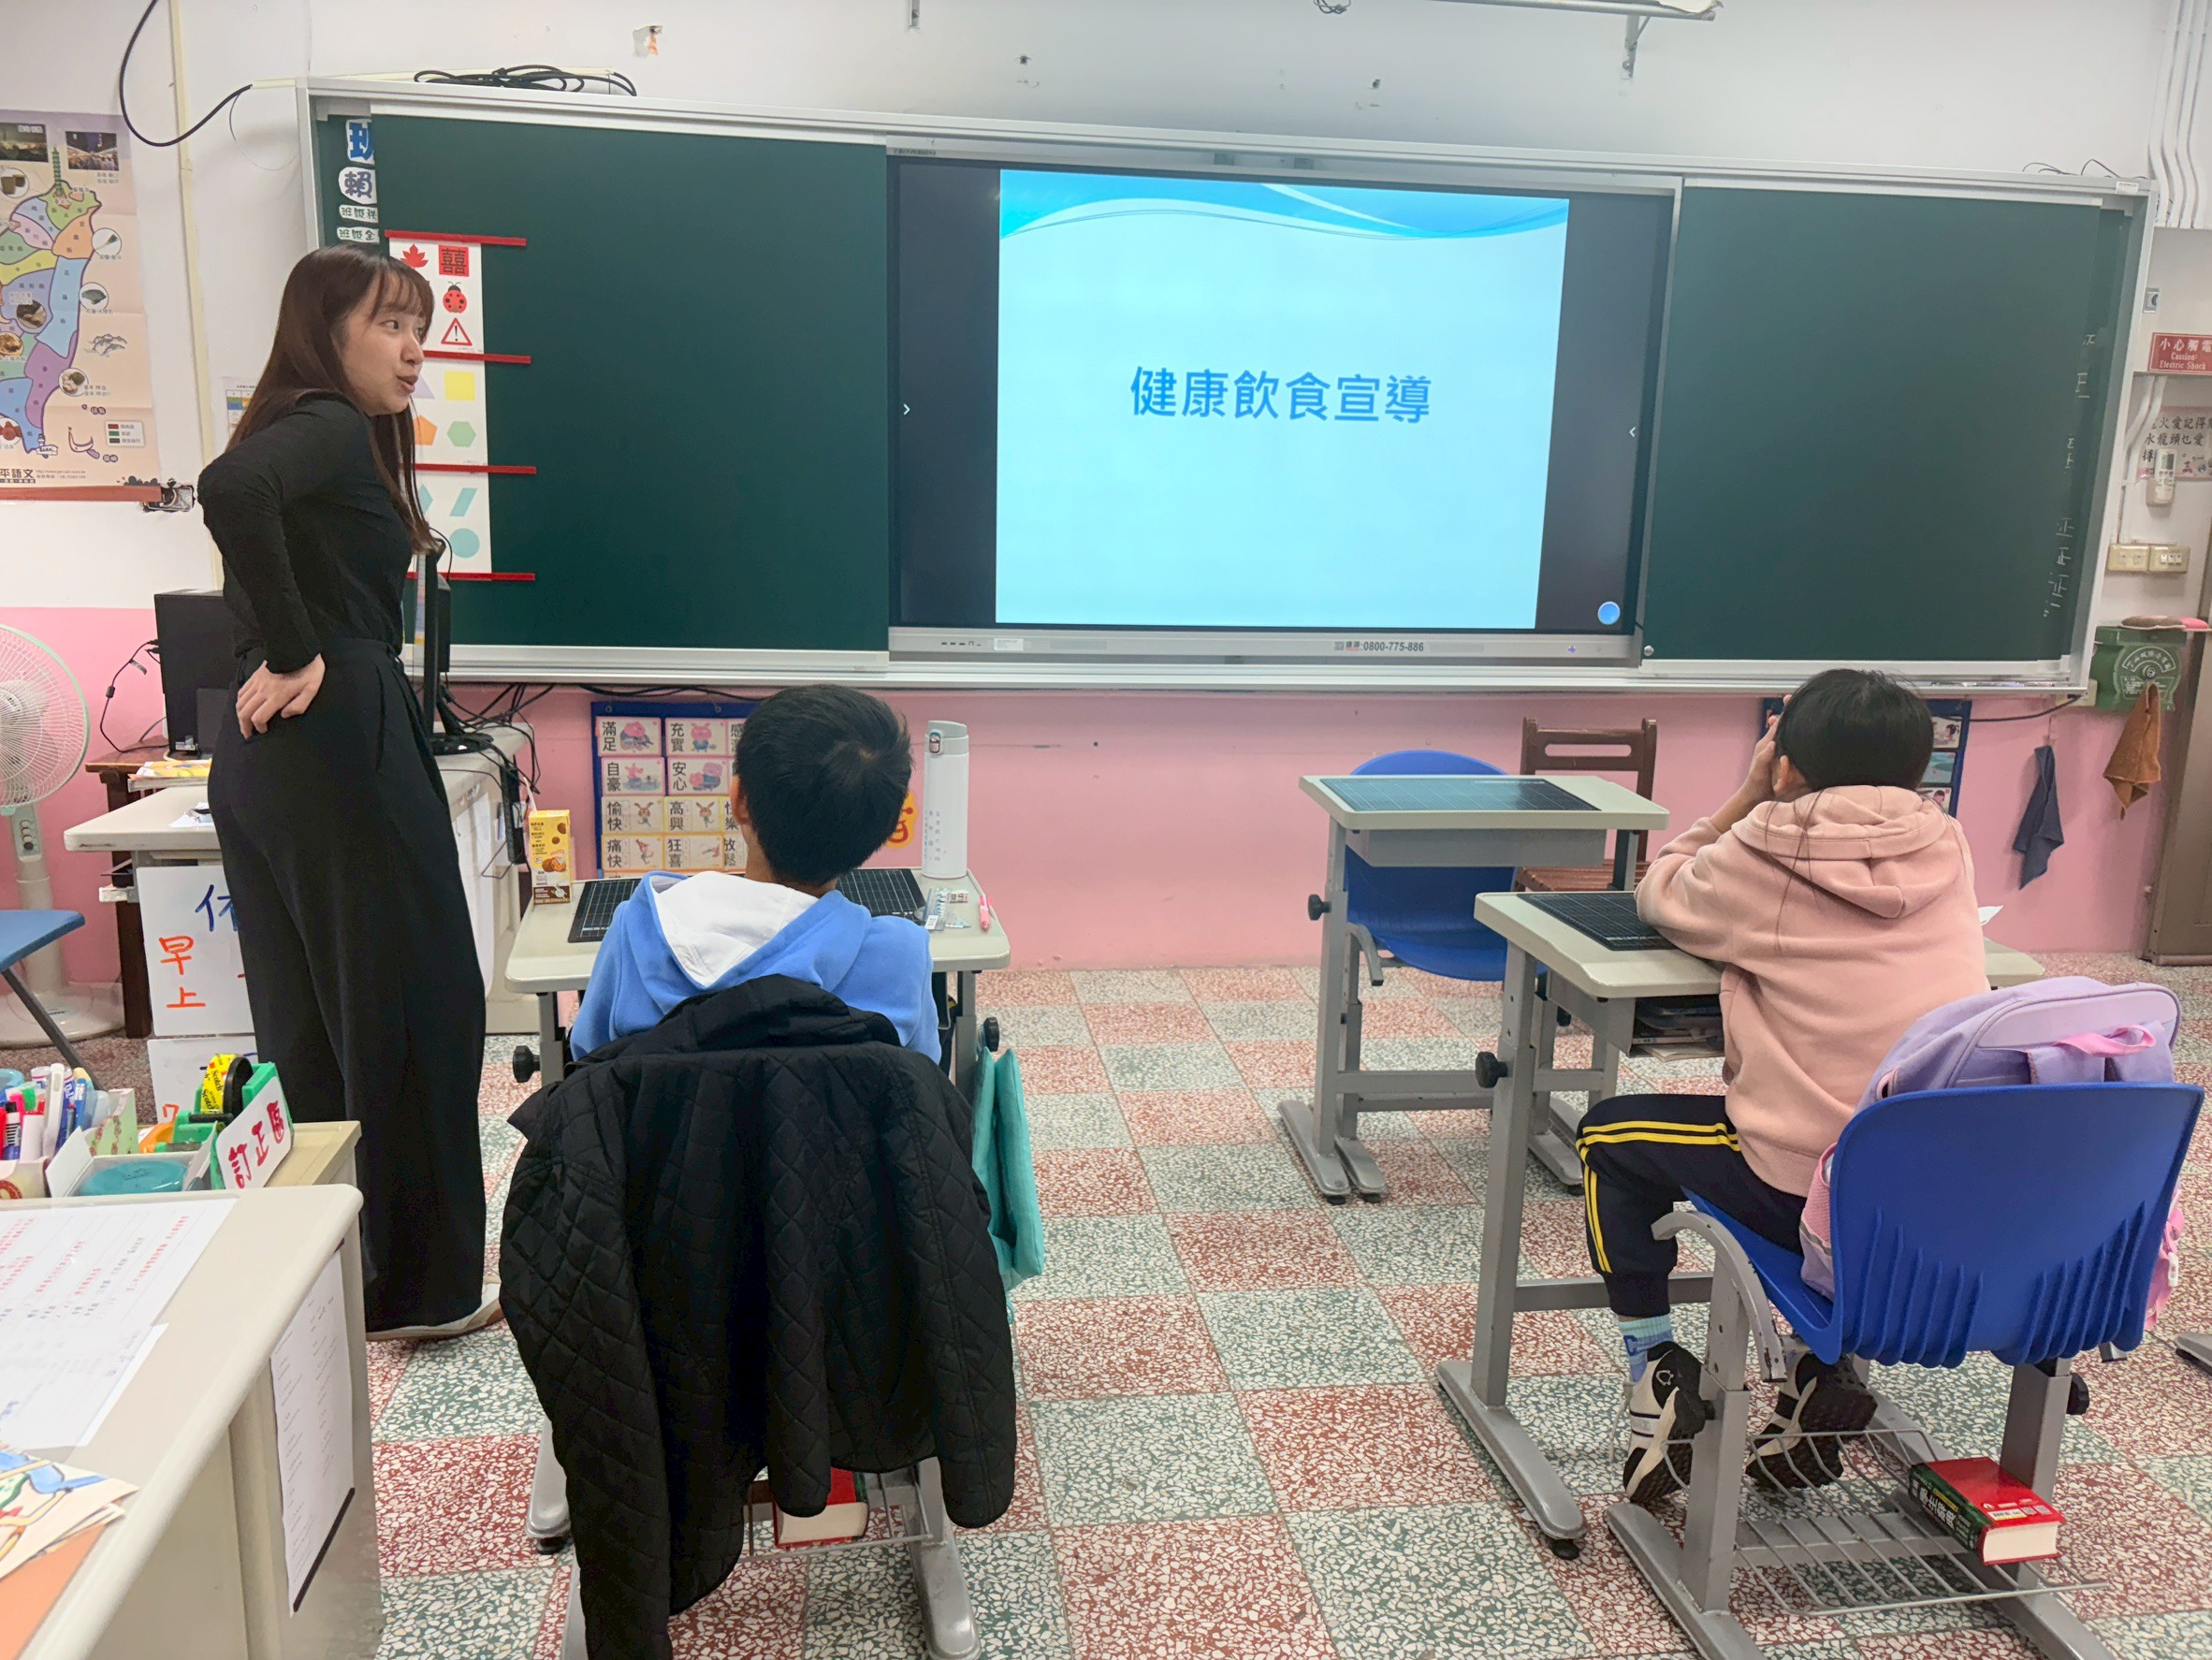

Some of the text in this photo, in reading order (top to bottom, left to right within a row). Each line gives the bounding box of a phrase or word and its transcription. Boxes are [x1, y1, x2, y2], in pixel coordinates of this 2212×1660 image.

[2159, 360, 2206, 371] Electric Shock
[1130, 366, 1432, 424] 健康飲食宣導
[2152, 416, 2212, 430] 火愛記得
[1363, 642, 1424, 653] 0800-775-886
[602, 721, 618, 752] 滿足
[670, 722, 685, 752] 充實
[606, 762, 621, 792] 自豪
[672, 762, 688, 792] 安心
[606, 801, 622, 831] 愉快
[668, 801, 684, 831] 高興
[606, 838, 622, 868] 痛快
[667, 838, 682, 868] 狂喜
[159, 936, 206, 1009] 早上
[212, 1070, 224, 1091] Scotch
